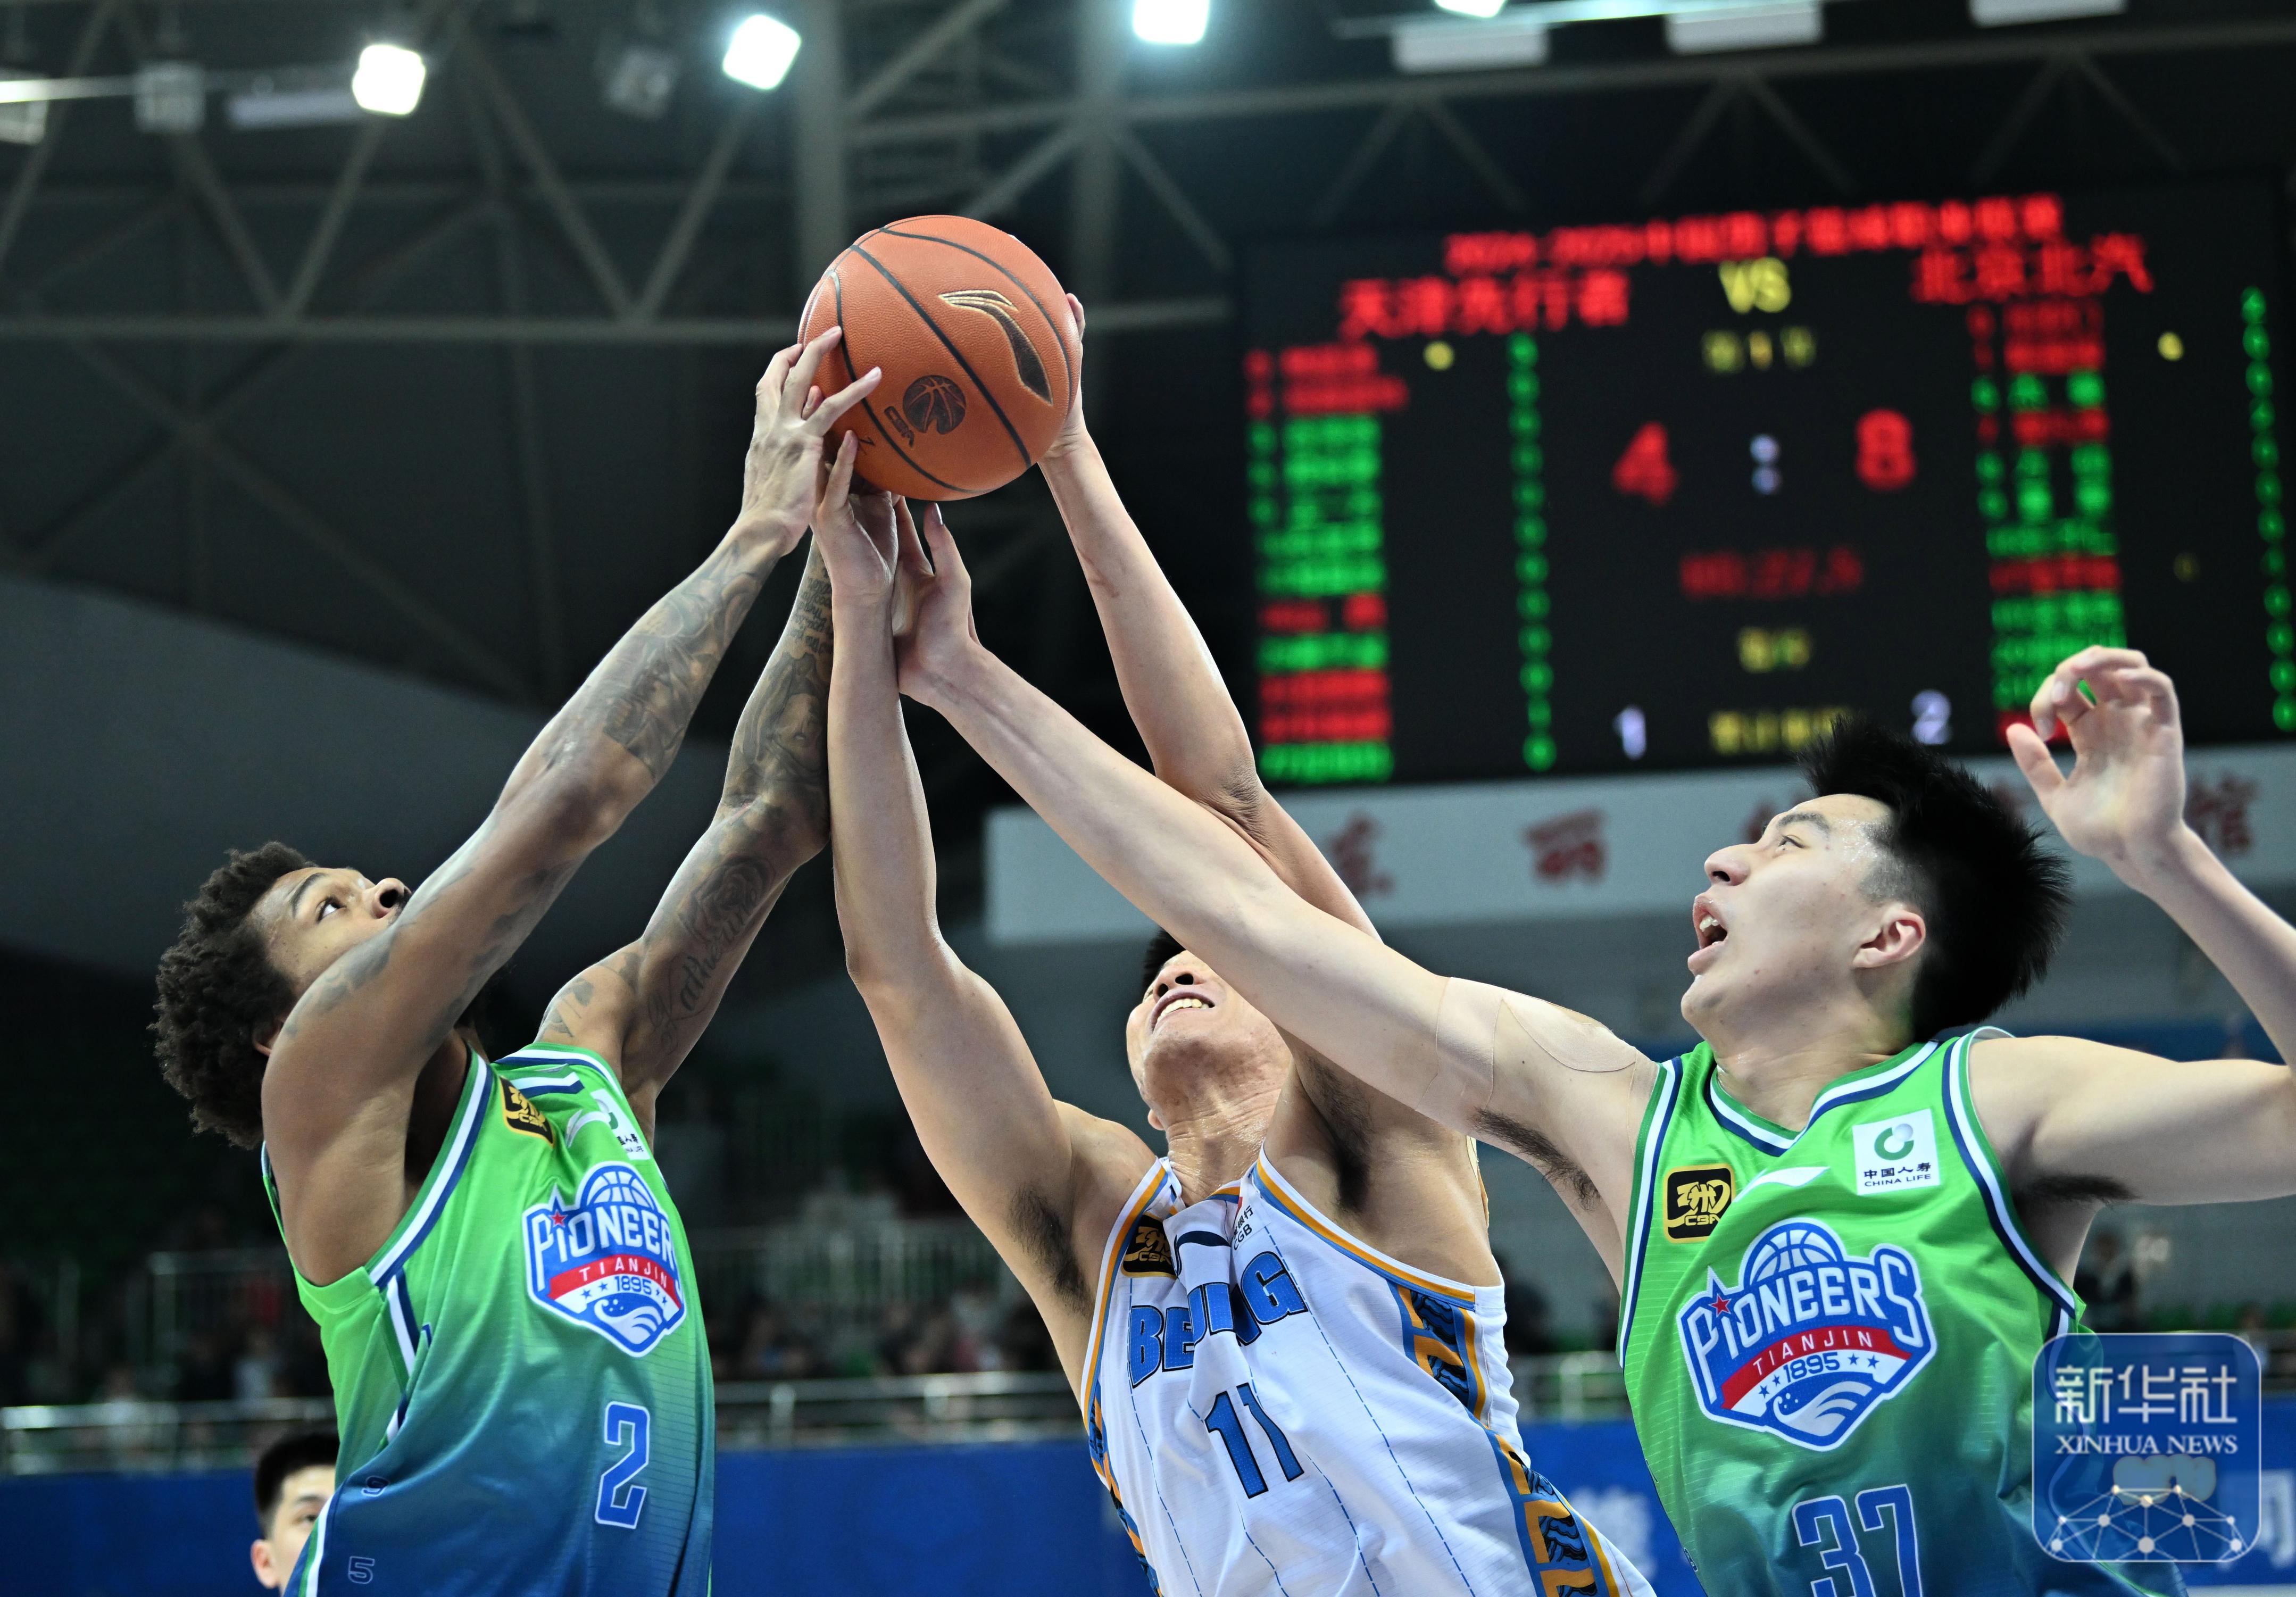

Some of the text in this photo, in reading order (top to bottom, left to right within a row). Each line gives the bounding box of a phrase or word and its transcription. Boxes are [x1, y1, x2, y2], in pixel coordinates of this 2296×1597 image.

[1719, 257, 1792, 314] VS
[1613, 422, 1677, 505] 4
[1856, 409, 1916, 490] 8
[1615, 705, 1646, 759] 1
[1911, 689, 1951, 745] 2
[1864, 1162, 1931, 1179] 中国人寿
[1864, 1174, 1931, 1187] CHINA LIFE
[531, 1205, 683, 1296] PIONEER
[1234, 1224, 1253, 1251] CGB
[579, 1257, 667, 1289] TIANJIN
[614, 1275, 652, 1296] 1895
[1686, 1254, 1924, 1404] PIONEERS
[1753, 1329, 1874, 1376] TIANJIN
[1783, 1351, 1841, 1383] 1895
[595, 1401, 650, 1529] 2
[1204, 1382, 1304, 1499] 11
[1792, 1483, 1923, 1597] 37
[347, 1556, 375, 1584] 5
